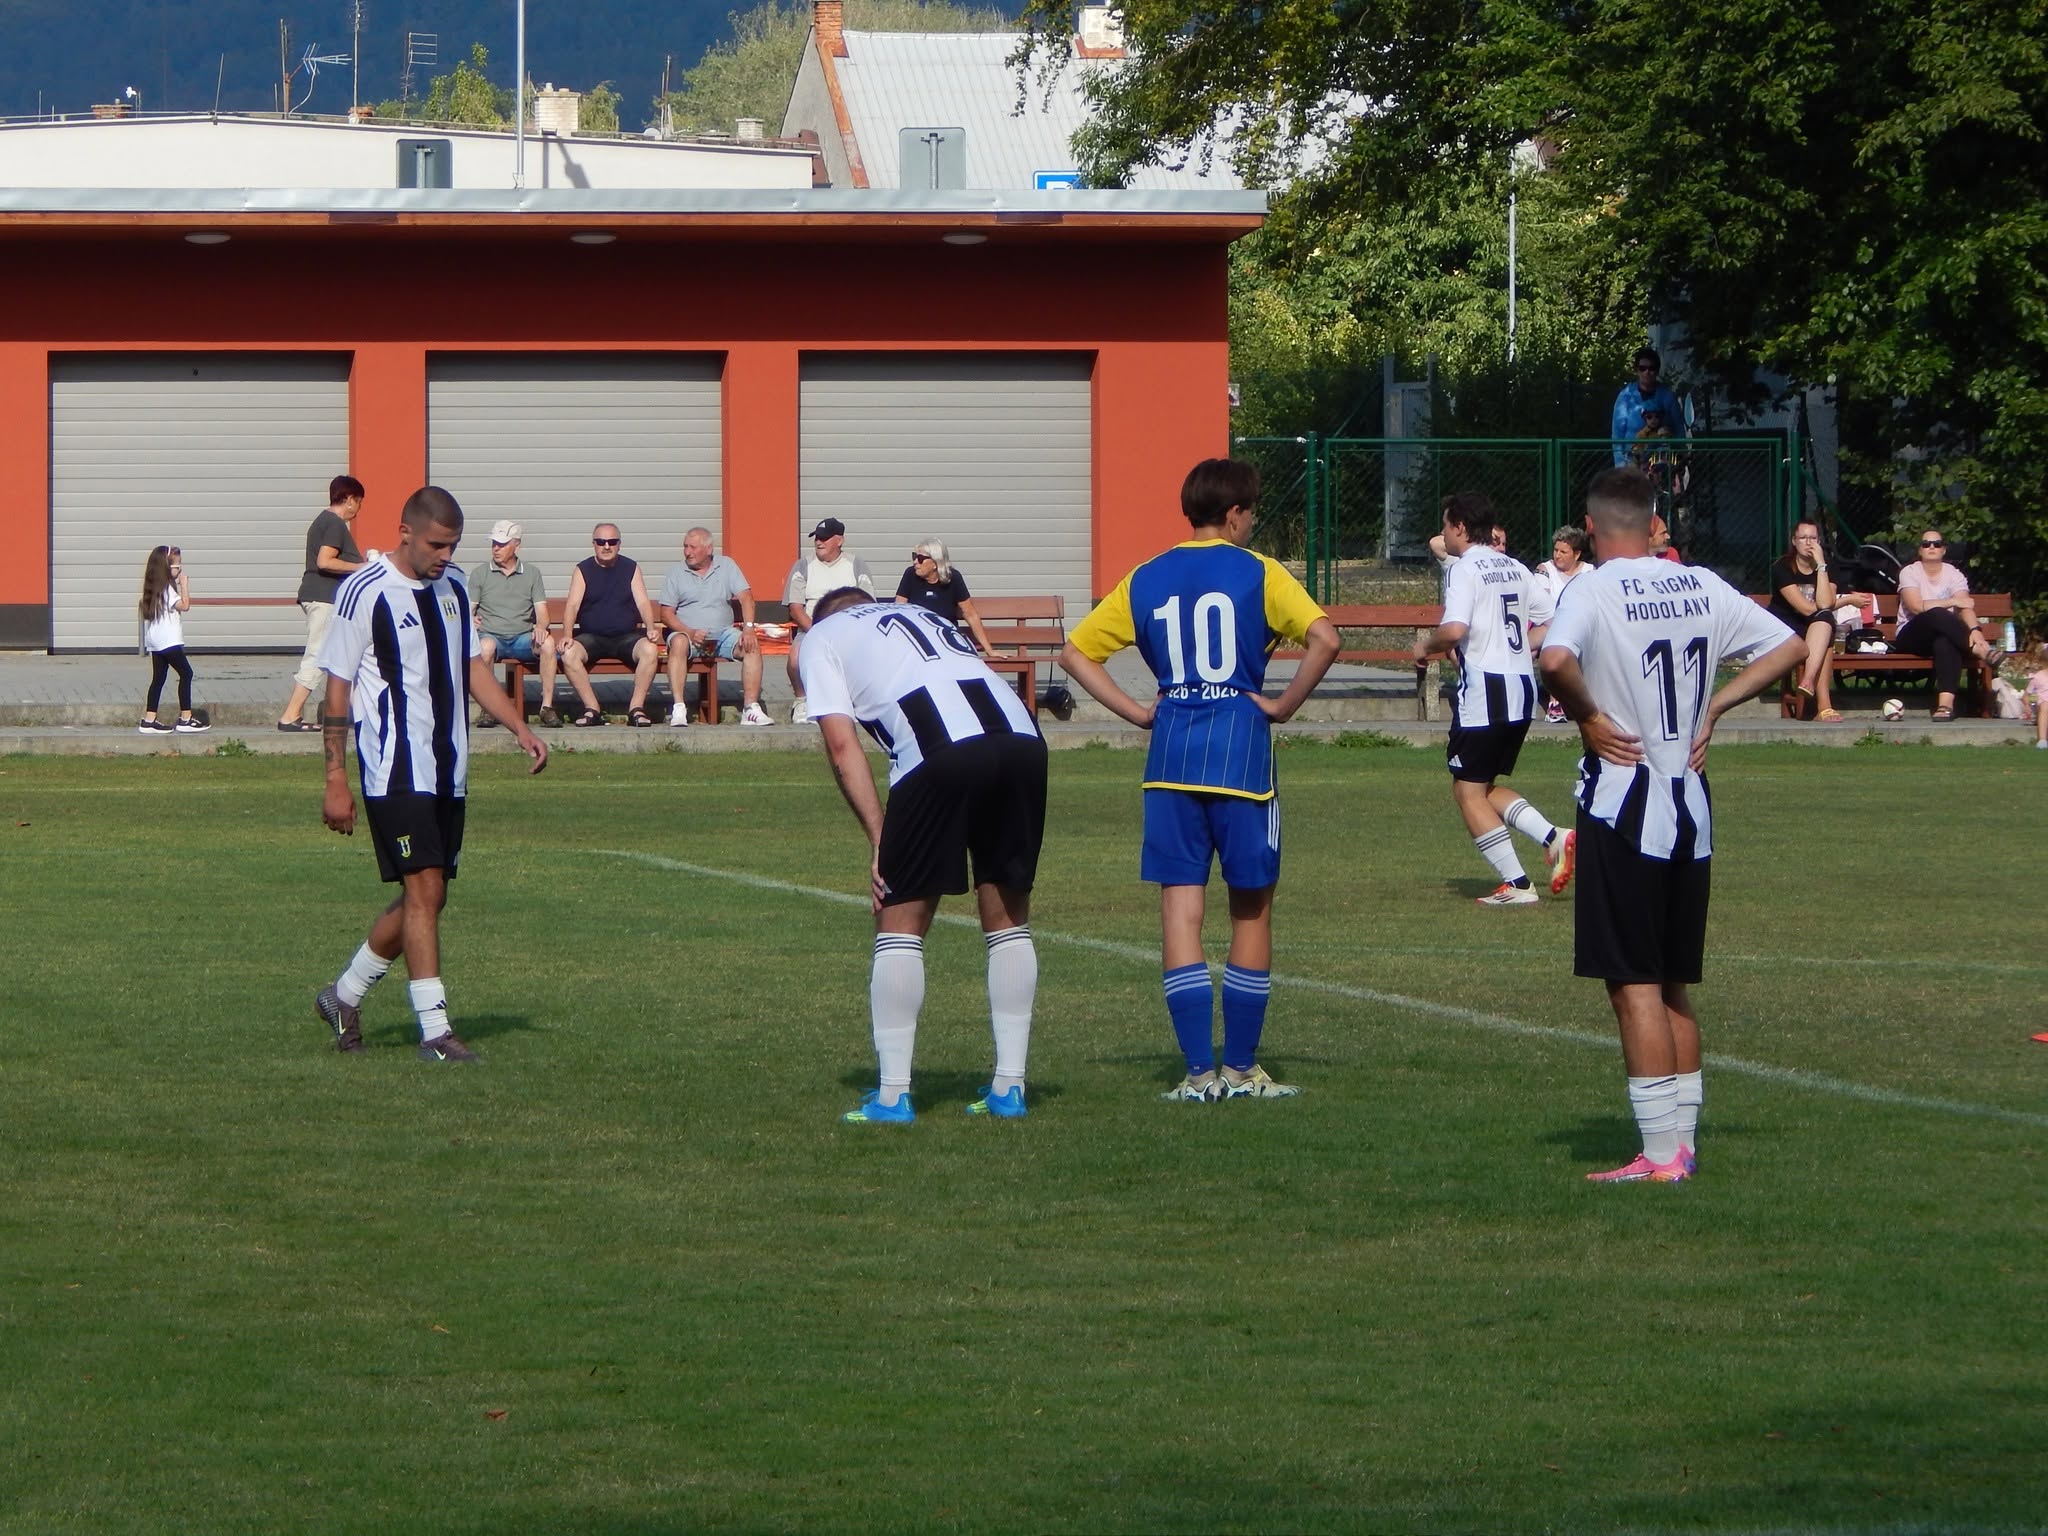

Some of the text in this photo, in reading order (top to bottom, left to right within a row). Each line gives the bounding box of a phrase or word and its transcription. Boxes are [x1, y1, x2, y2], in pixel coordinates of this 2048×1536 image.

[1620, 574, 1703, 596] FC SIGMA
[1625, 596, 1711, 622] HODOLANY
[876, 611, 980, 663] 18
[1153, 591, 1237, 684] 10
[1500, 593, 1524, 655] 5
[1641, 636, 1708, 742] 11
